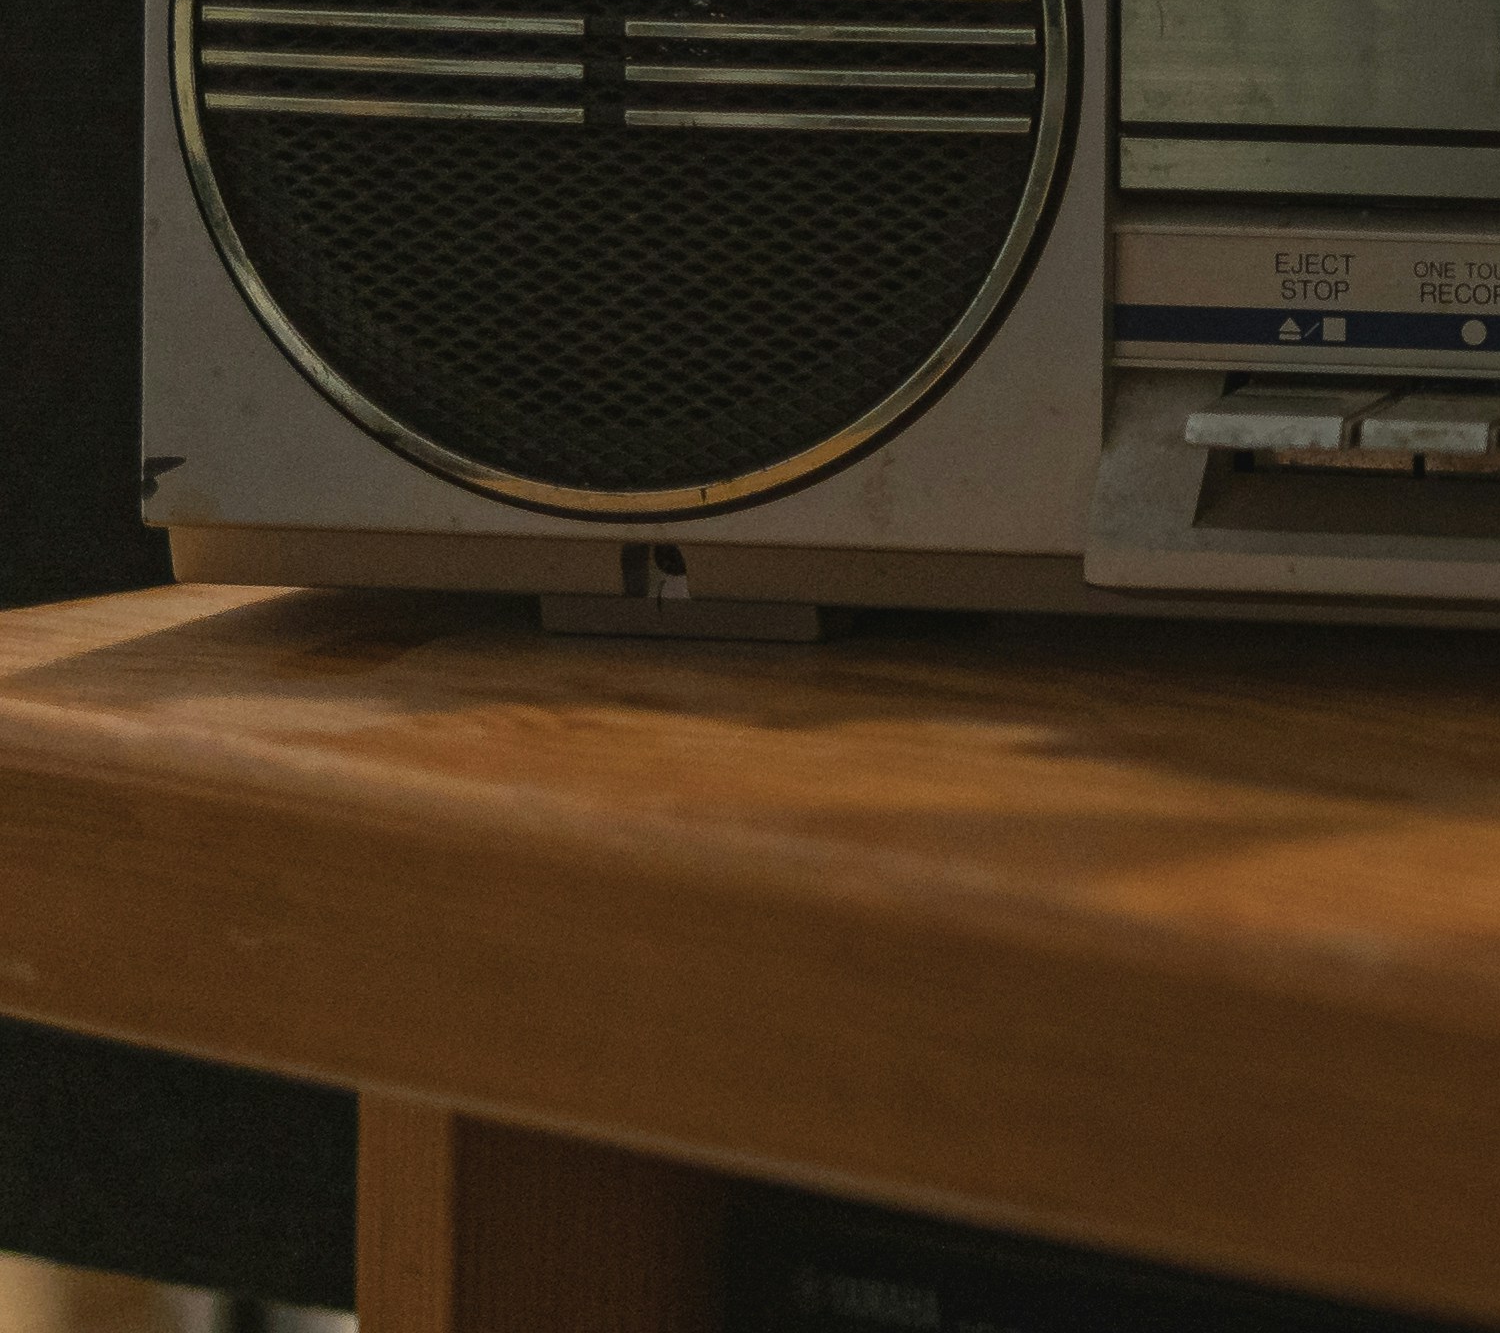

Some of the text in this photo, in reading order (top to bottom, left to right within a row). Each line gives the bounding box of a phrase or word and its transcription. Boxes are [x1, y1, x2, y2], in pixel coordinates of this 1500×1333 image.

[1275, 253, 1355, 276] EJECT
[1413, 260, 1456, 279] ONE
[1281, 279, 1350, 301] STOP
